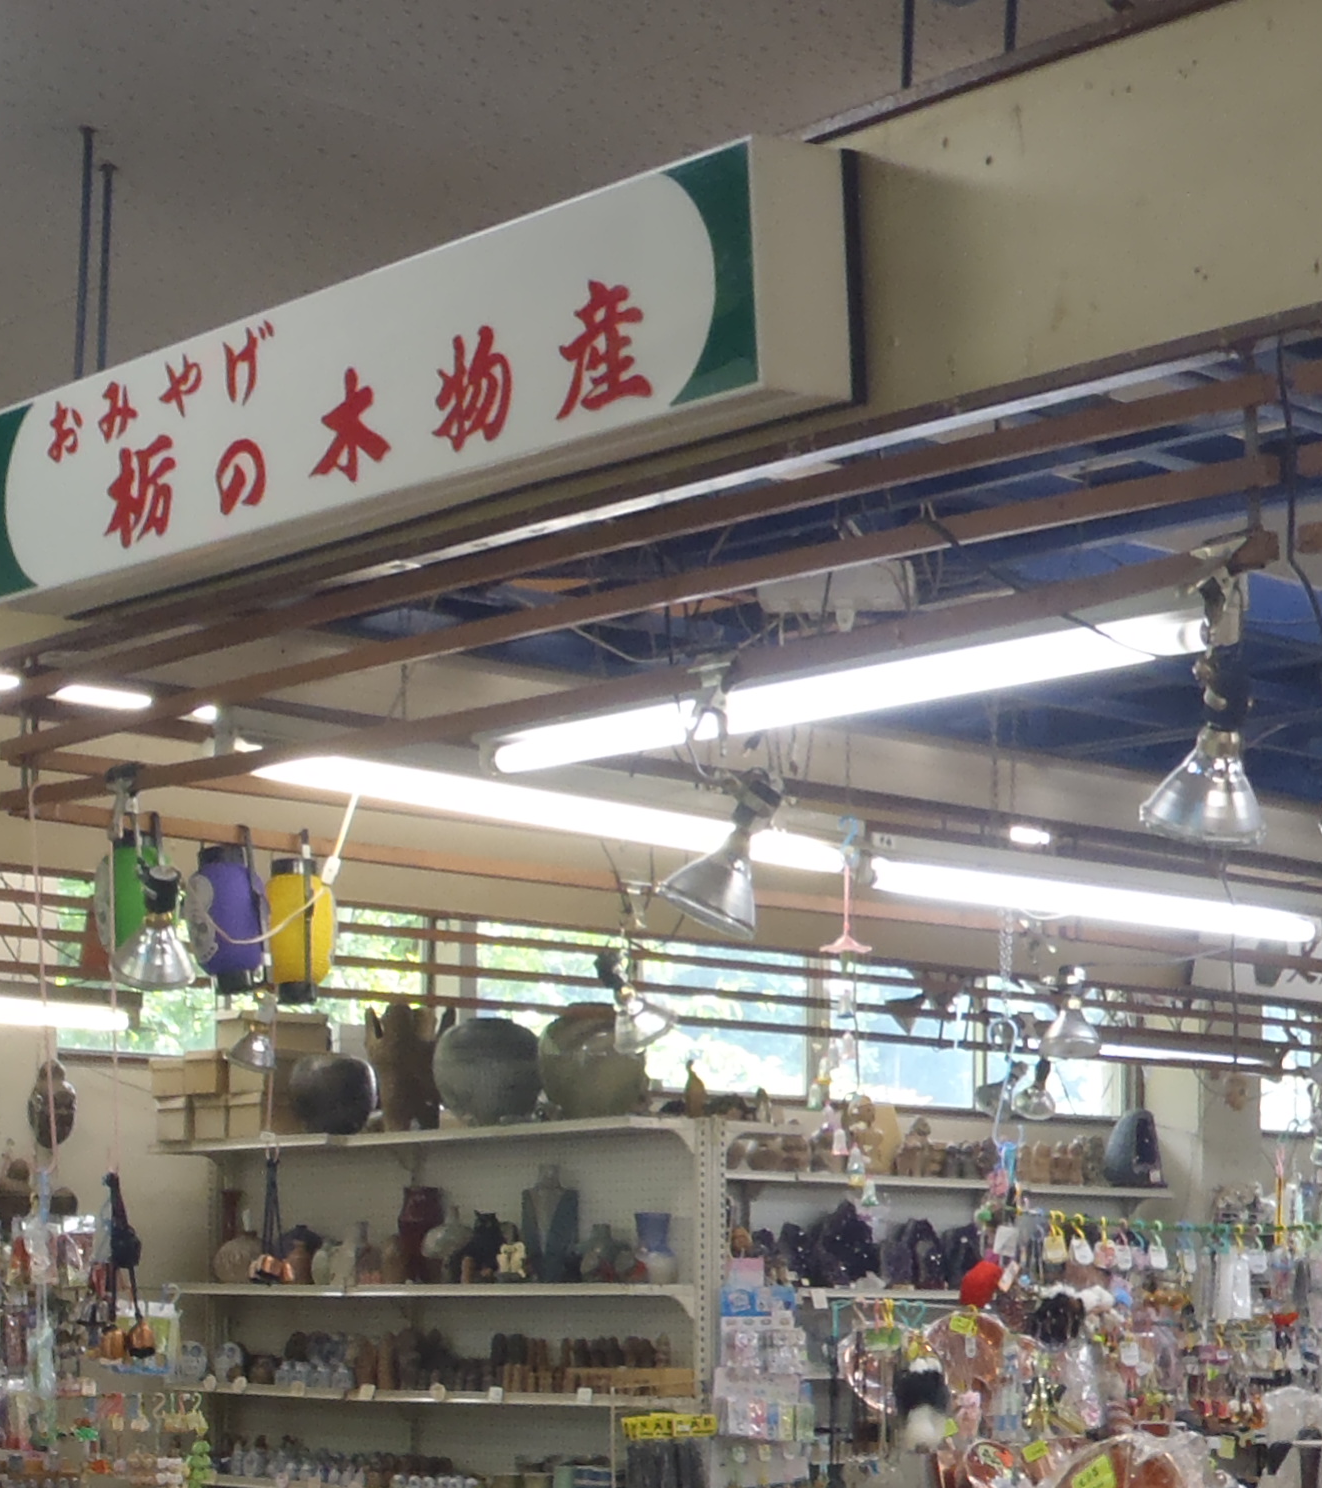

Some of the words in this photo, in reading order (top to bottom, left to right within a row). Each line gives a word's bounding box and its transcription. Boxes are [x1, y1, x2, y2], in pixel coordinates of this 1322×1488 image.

[48, 321, 274, 464] おみやげ
[104, 281, 653, 549] 栃の木物産
